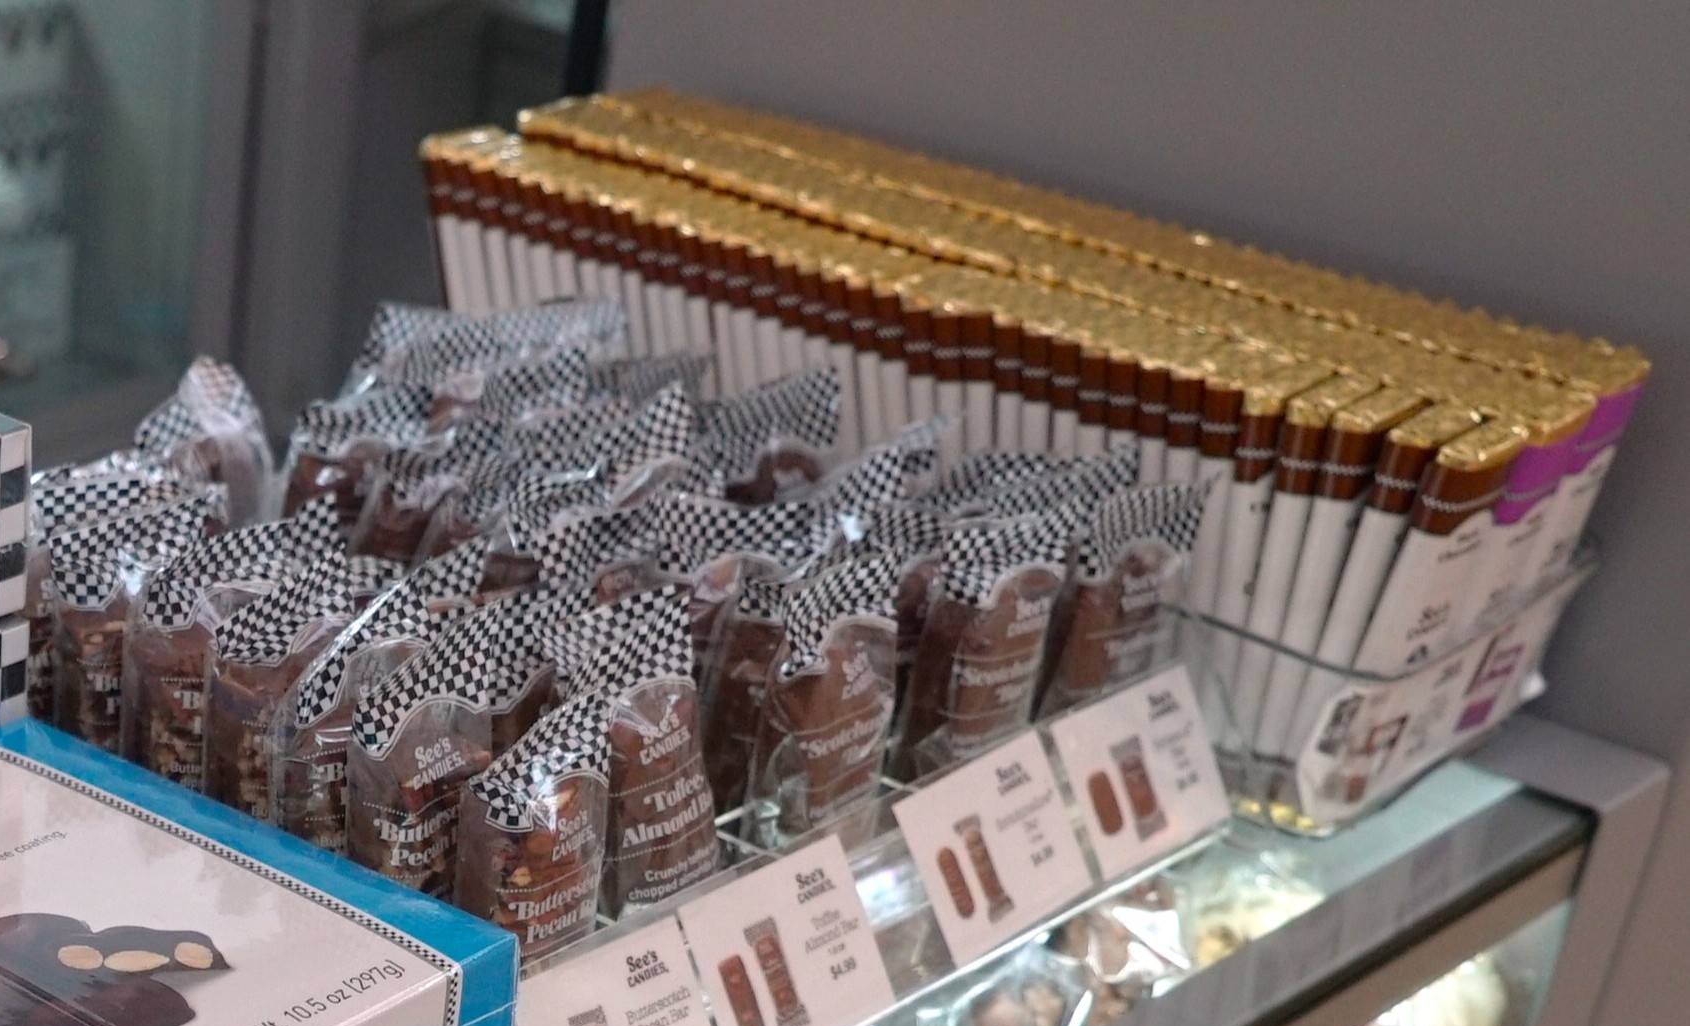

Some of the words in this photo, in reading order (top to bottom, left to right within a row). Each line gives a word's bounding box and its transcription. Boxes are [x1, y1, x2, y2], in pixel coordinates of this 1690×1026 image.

[415, 737, 452, 770] See's
[557, 810, 589, 841] See's
[621, 797, 700, 849] Almond
[628, 878, 679, 902] chopped
[626, 950, 659, 973] See's
[284, 997, 327, 1024] 10.5
[326, 988, 352, 1005] oz
[342, 959, 406, 995] (297g)
[625, 985, 691, 1026] Butterscotch
[668, 1005, 690, 1024] Bar
